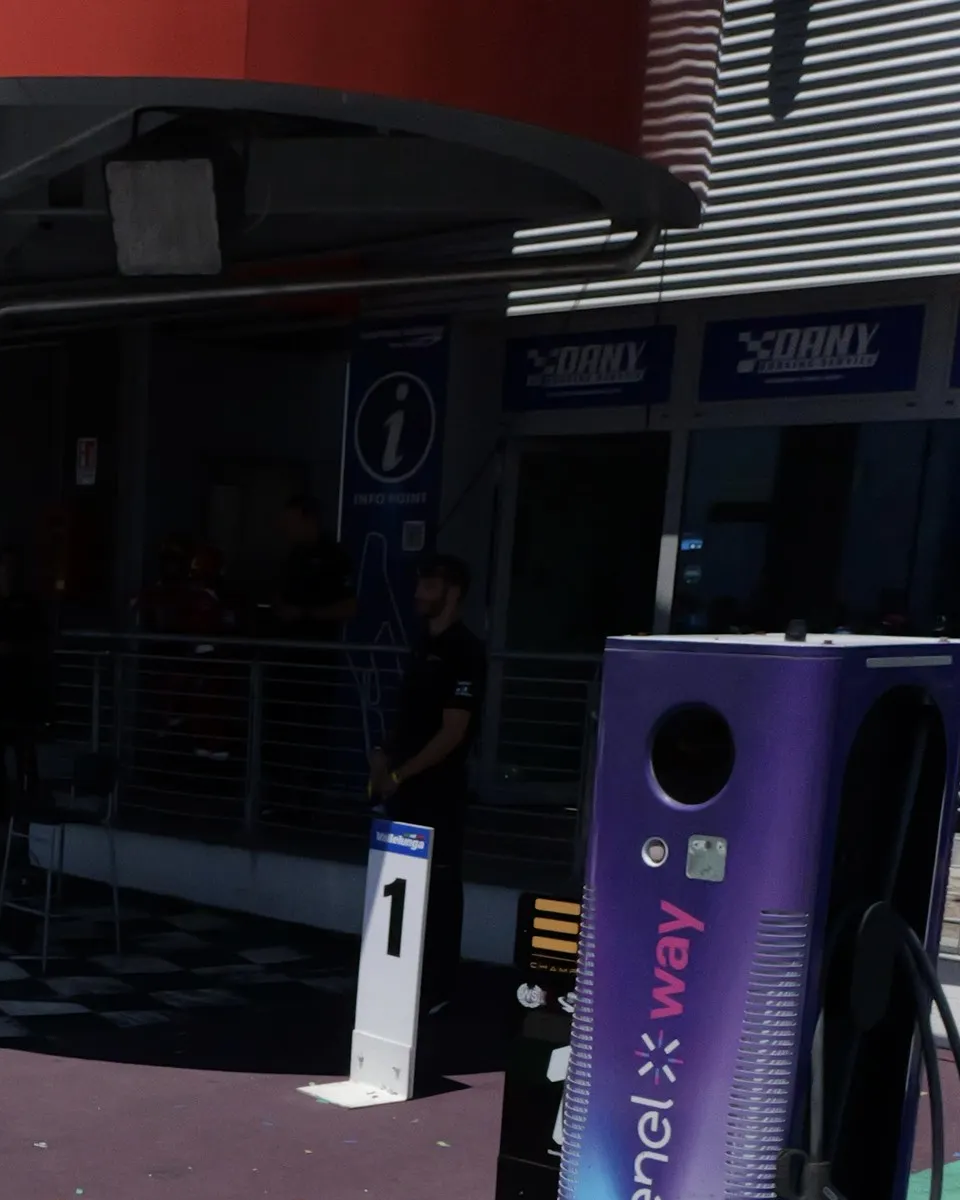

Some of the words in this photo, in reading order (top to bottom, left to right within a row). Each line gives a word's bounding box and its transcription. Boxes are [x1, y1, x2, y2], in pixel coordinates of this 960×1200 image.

[772, 322, 881, 359] DANY
[353, 492, 384, 505] INFO
[383, 877, 407, 958] 1
[649, 901, 706, 1020] way
